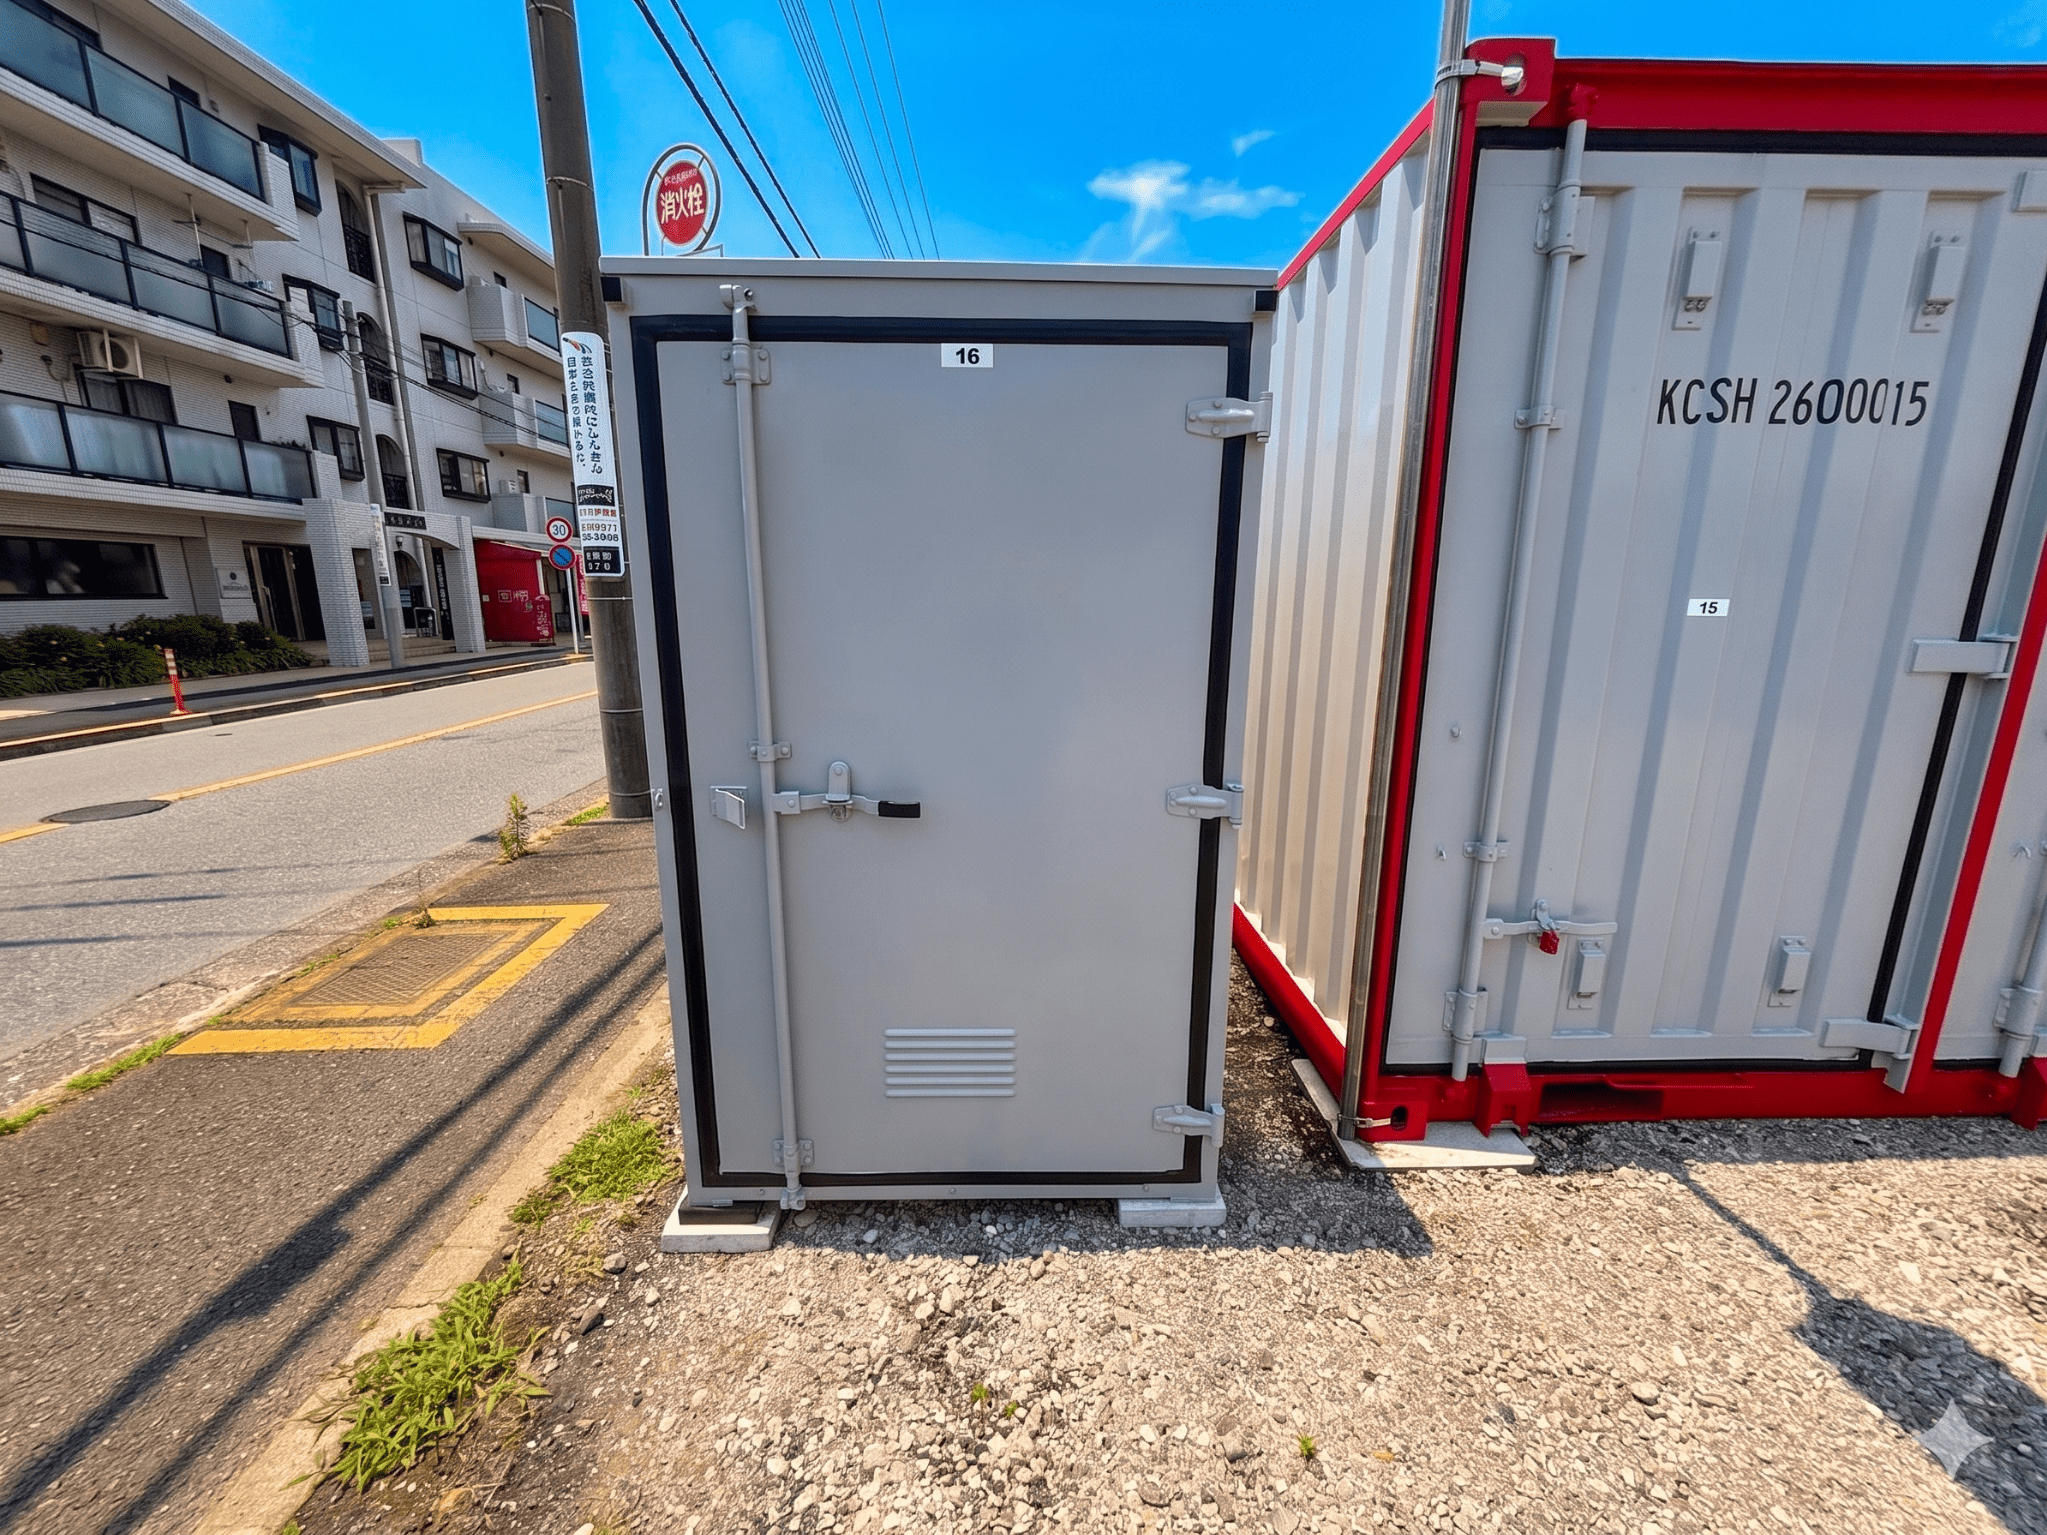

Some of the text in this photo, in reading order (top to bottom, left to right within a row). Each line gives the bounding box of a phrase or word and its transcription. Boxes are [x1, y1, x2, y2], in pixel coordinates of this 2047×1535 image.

[956, 347, 980, 365] 16
[1656, 377, 1930, 427] KCSH 2600015
[552, 524, 567, 537] 30
[1699, 601, 1718, 614] 15
